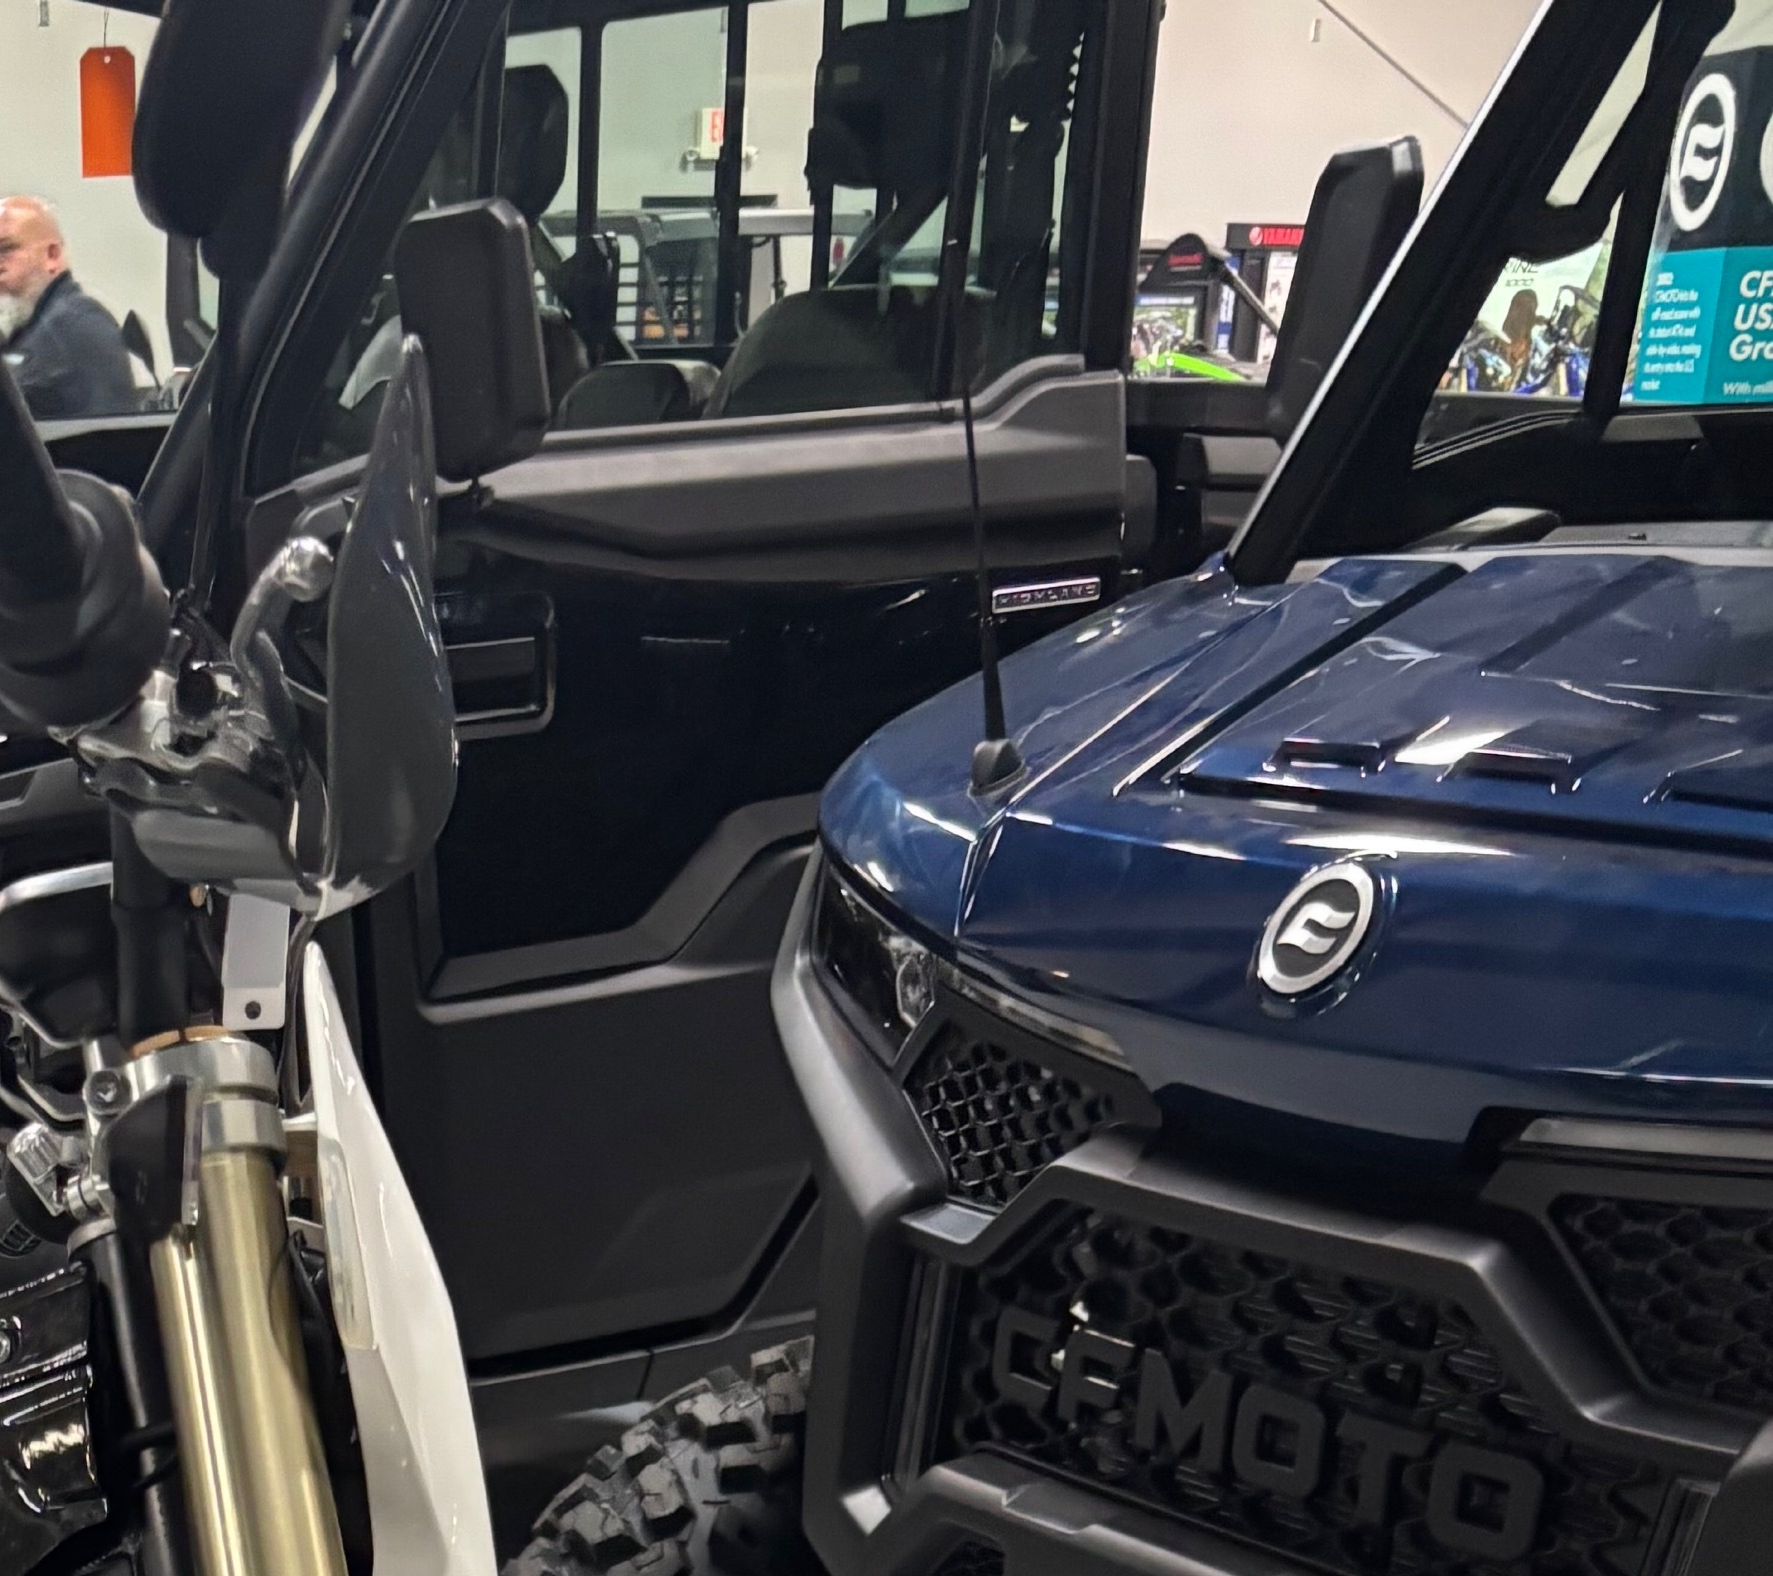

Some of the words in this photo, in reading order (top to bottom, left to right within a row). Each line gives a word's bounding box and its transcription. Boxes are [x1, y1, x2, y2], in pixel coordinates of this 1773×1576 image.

[1739, 270, 1773, 298] CF
[1734, 302, 1773, 331] US
[993, 1306, 1544, 1562] CFMOTO
